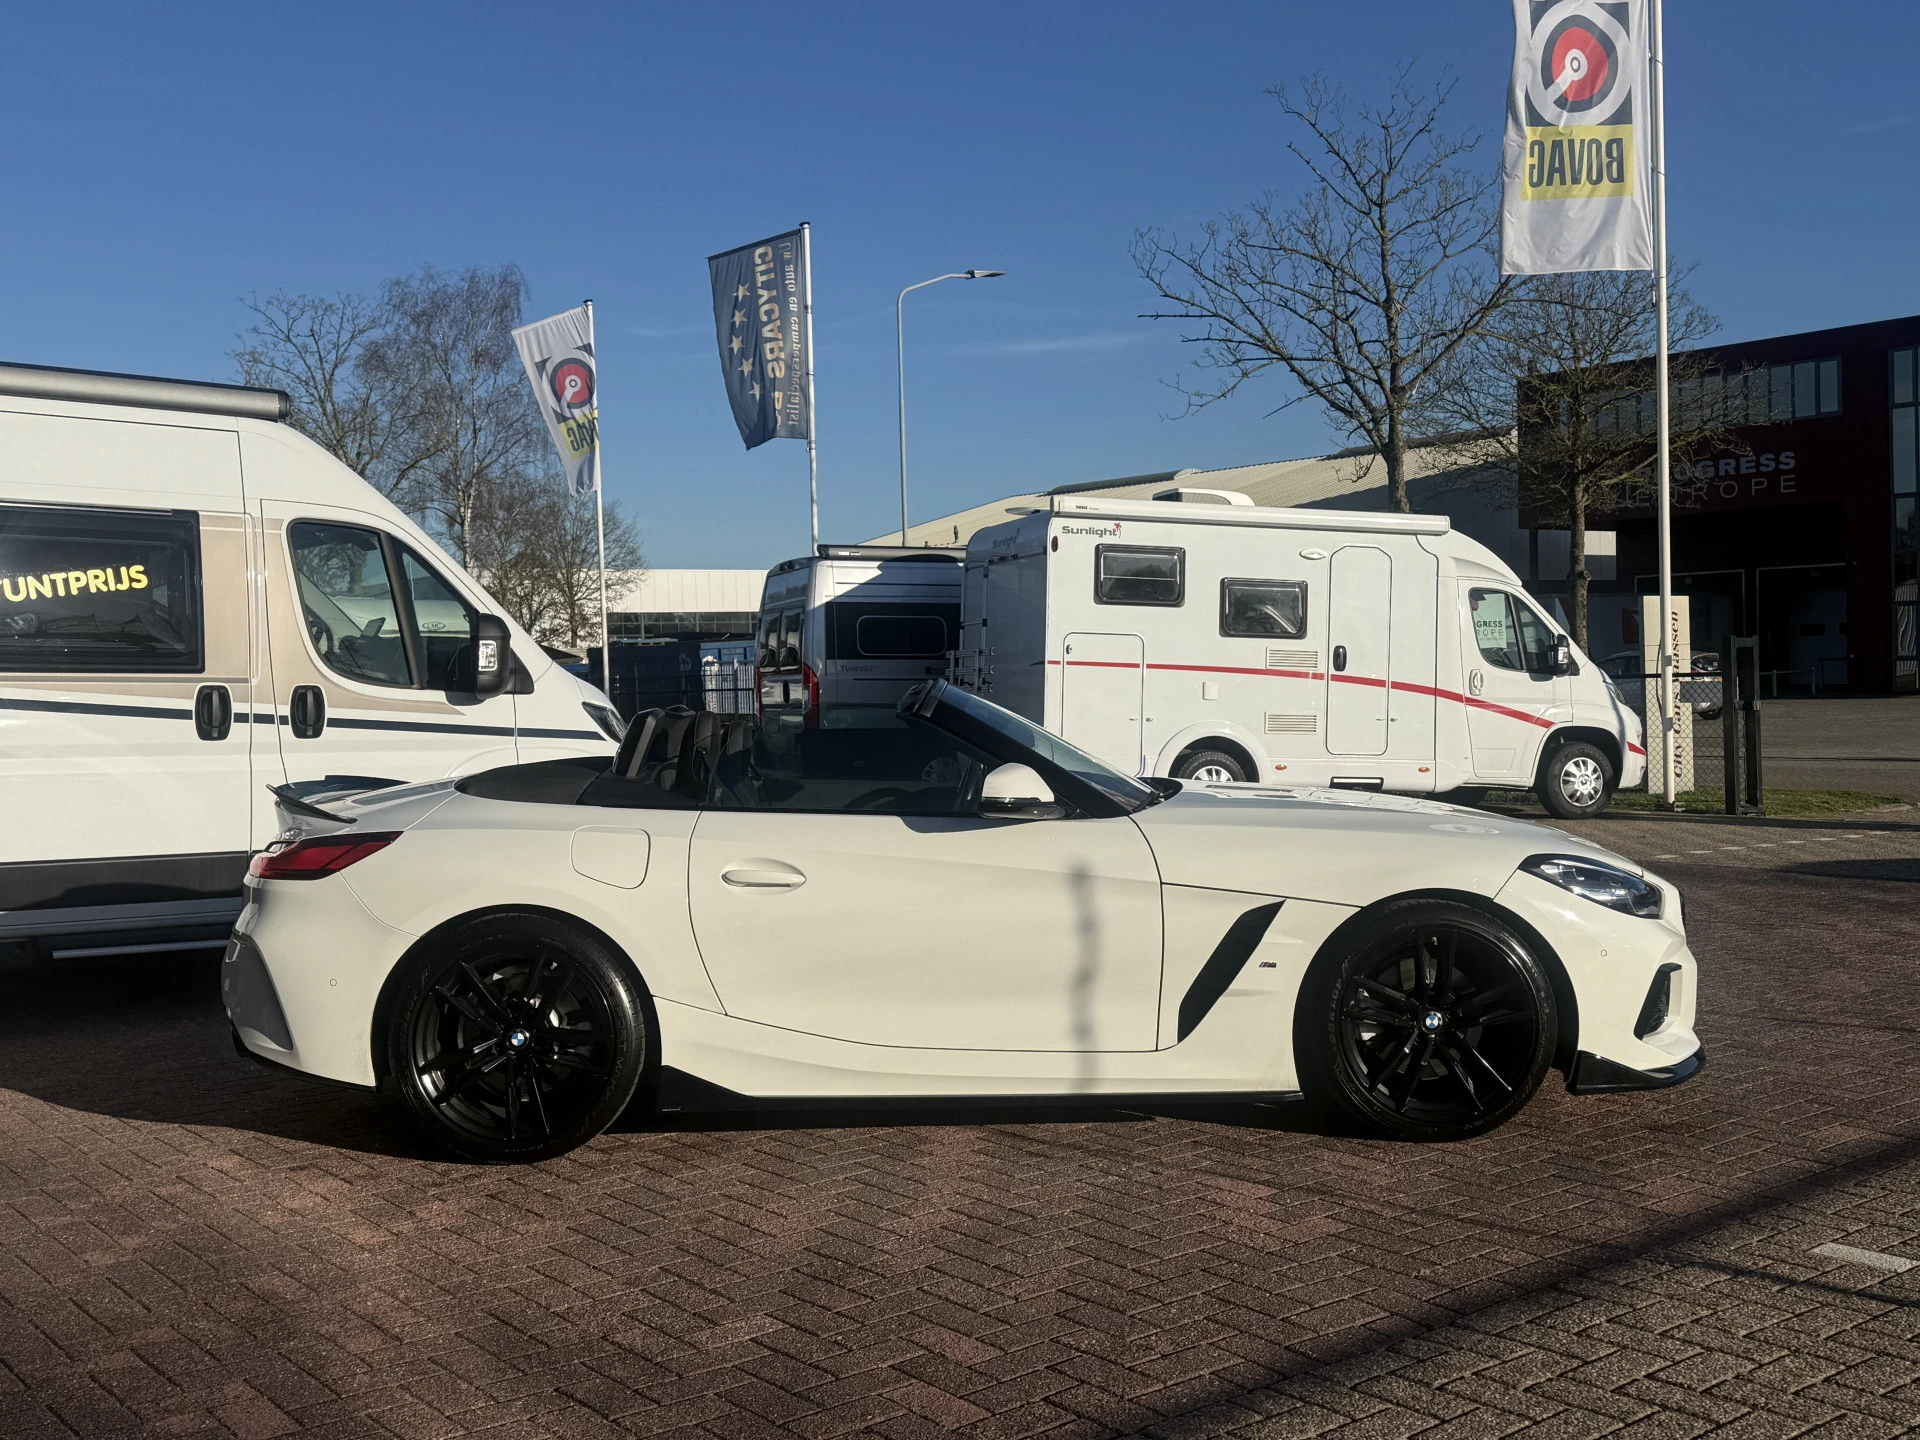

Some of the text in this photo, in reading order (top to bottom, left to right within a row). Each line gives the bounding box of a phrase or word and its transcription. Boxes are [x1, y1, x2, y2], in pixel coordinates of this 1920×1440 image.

[1061, 525, 1117, 538] Sunlight
[0, 565, 149, 603] UNTPRIJS
[1674, 744, 1684, 778] City
